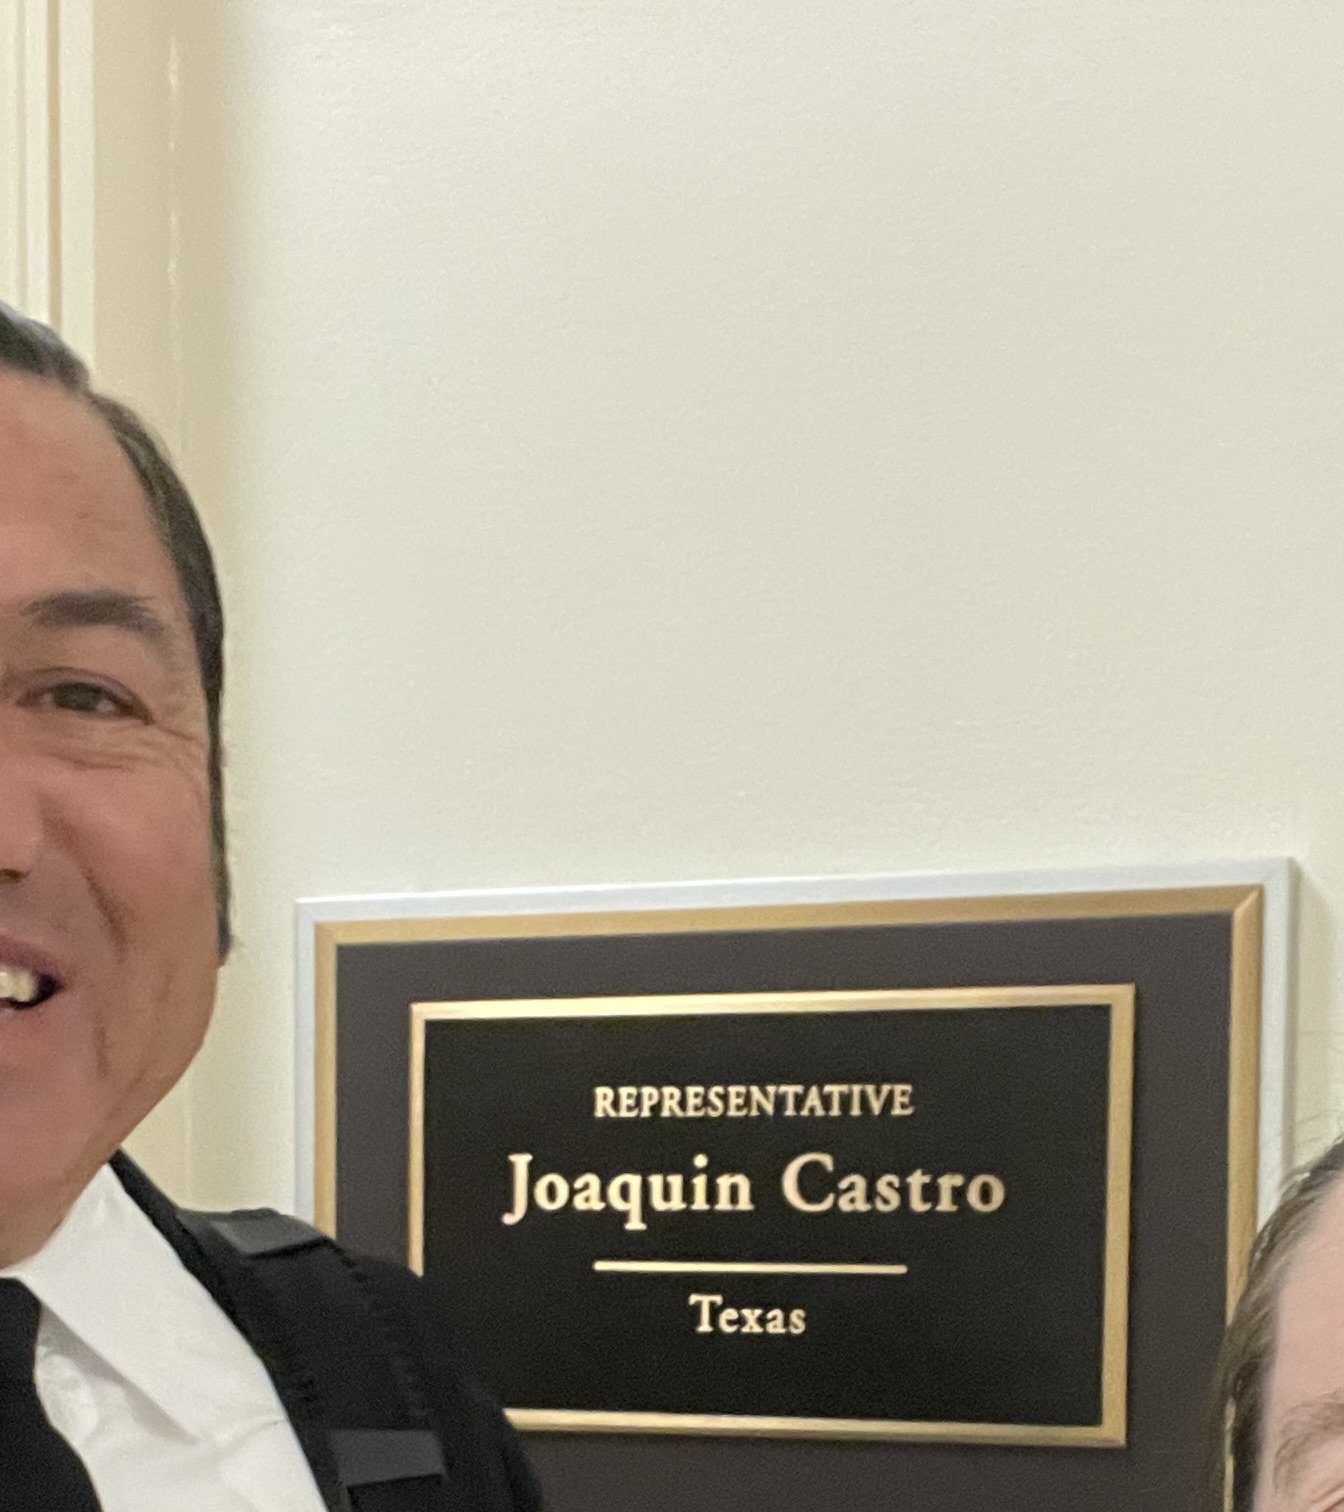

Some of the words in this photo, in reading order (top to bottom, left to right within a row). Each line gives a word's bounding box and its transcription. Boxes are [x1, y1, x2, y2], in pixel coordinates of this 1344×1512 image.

[593, 1083, 915, 1118] REPRESENTATIVE
[501, 1152, 755, 1231] Joaquin
[781, 1151, 1006, 1214] Castro
[688, 1292, 807, 1336] Texas
